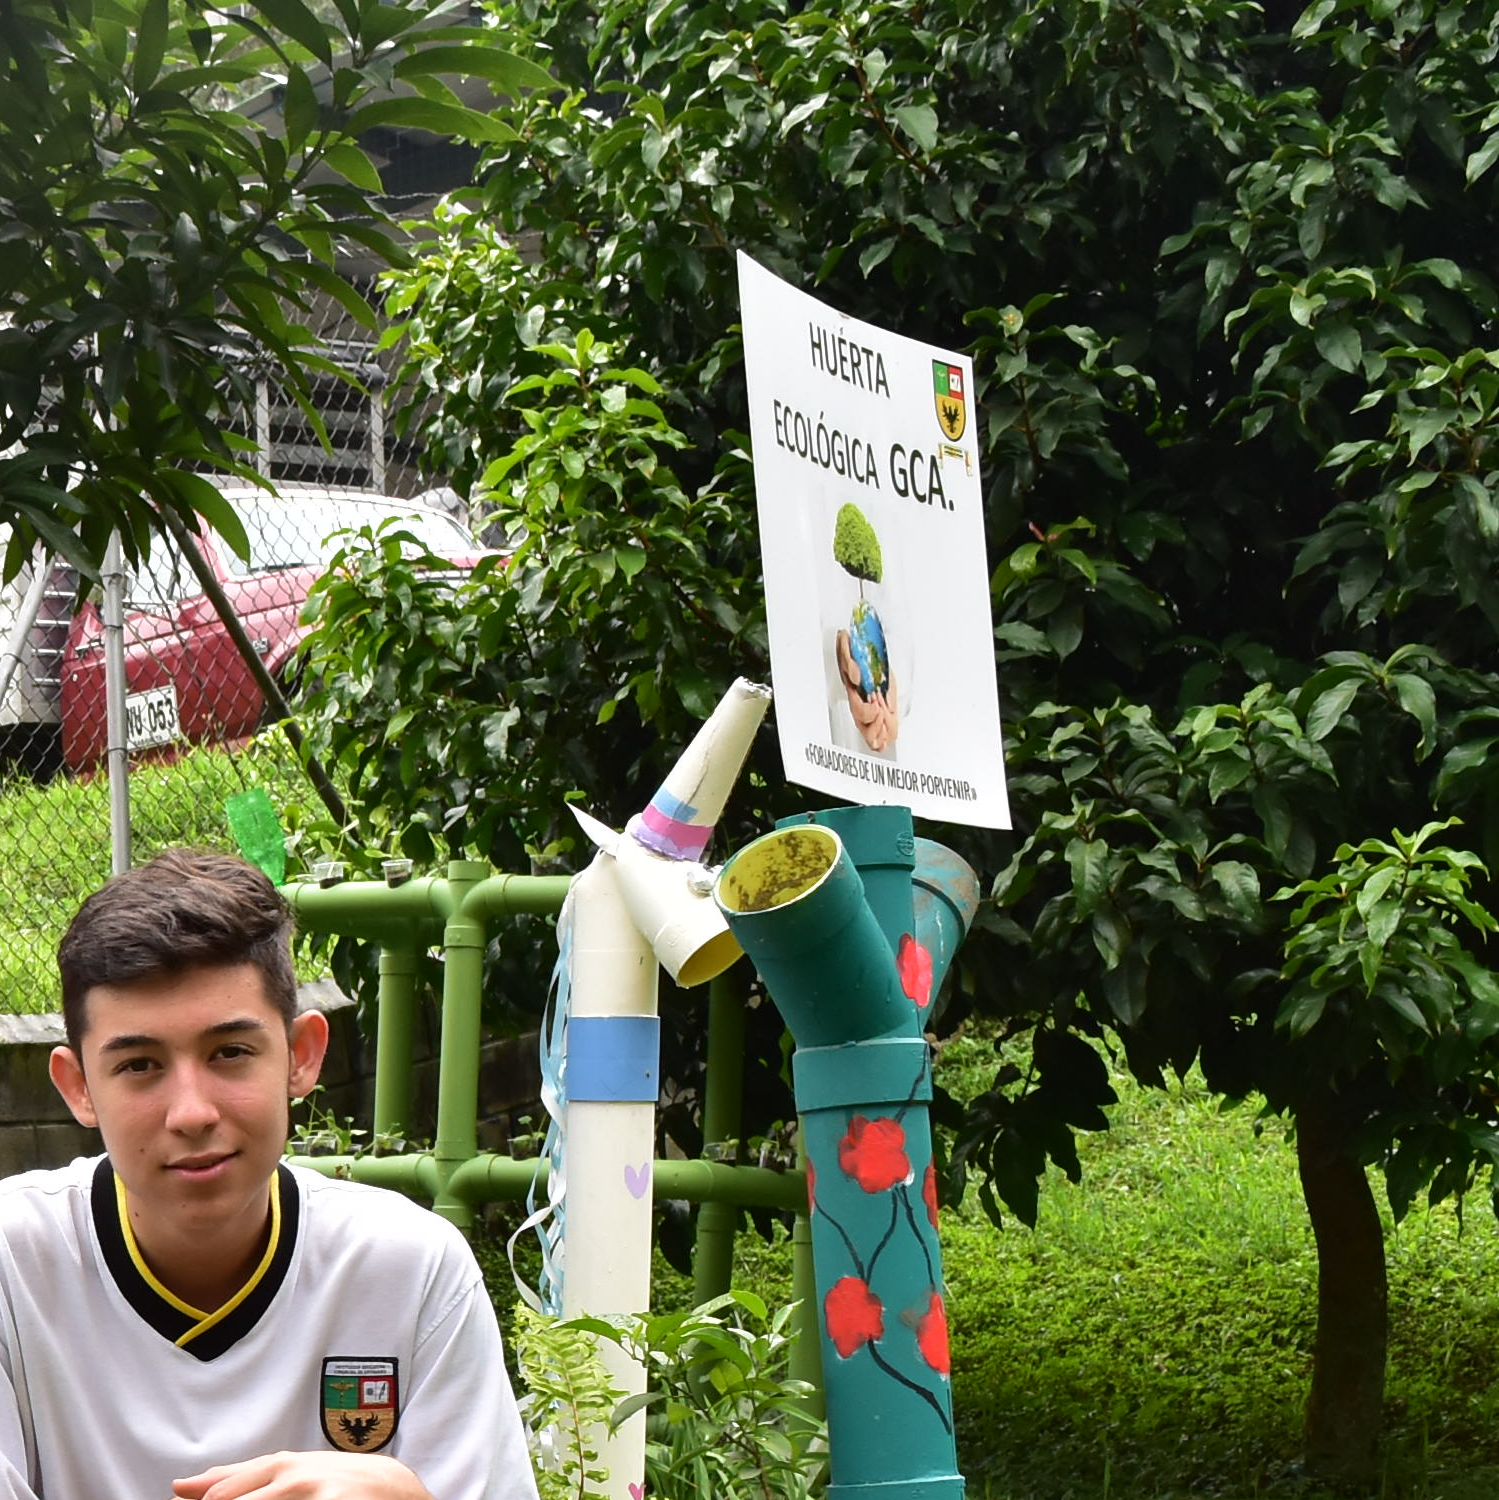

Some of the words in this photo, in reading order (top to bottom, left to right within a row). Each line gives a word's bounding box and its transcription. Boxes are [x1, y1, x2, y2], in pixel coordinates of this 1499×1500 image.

[774, 399, 880, 489] ECOLÓGICA
[890, 443, 954, 511] GCA.
[148, 698, 175, 732] 053
[859, 759, 870, 782] DE
[871, 762, 885, 786] UN
[886, 767, 919, 792] MEJOR
